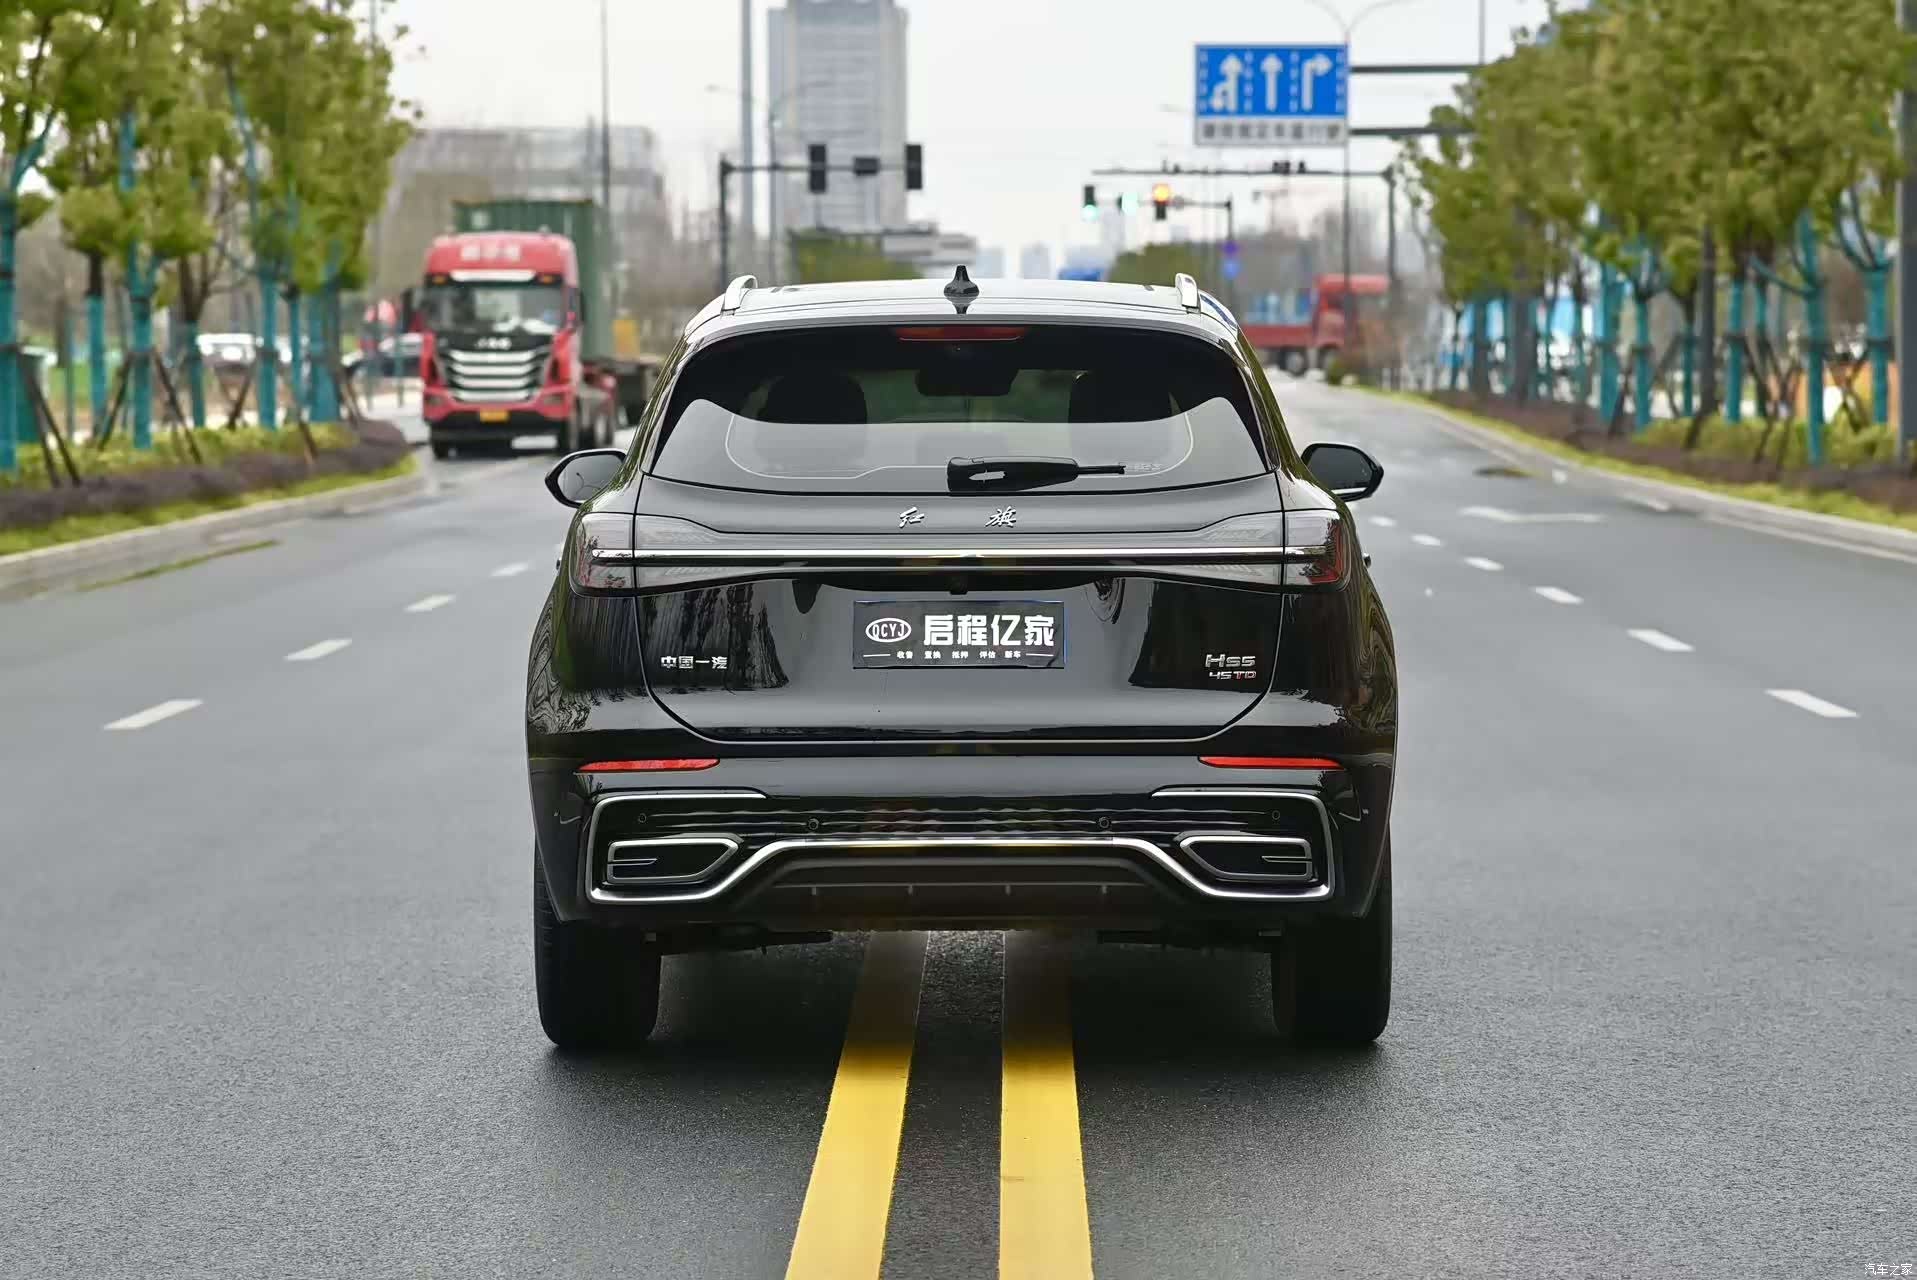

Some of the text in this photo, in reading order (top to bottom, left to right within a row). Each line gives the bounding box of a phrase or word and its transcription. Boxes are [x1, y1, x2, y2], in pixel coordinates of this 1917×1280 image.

[899, 506, 1017, 528] 红旗
[871, 622, 905, 638] QCYJ
[923, 614, 1055, 647] 启程亿家
[660, 655, 728, 669] 中国一汽
[1205, 653, 1256, 668] HS5
